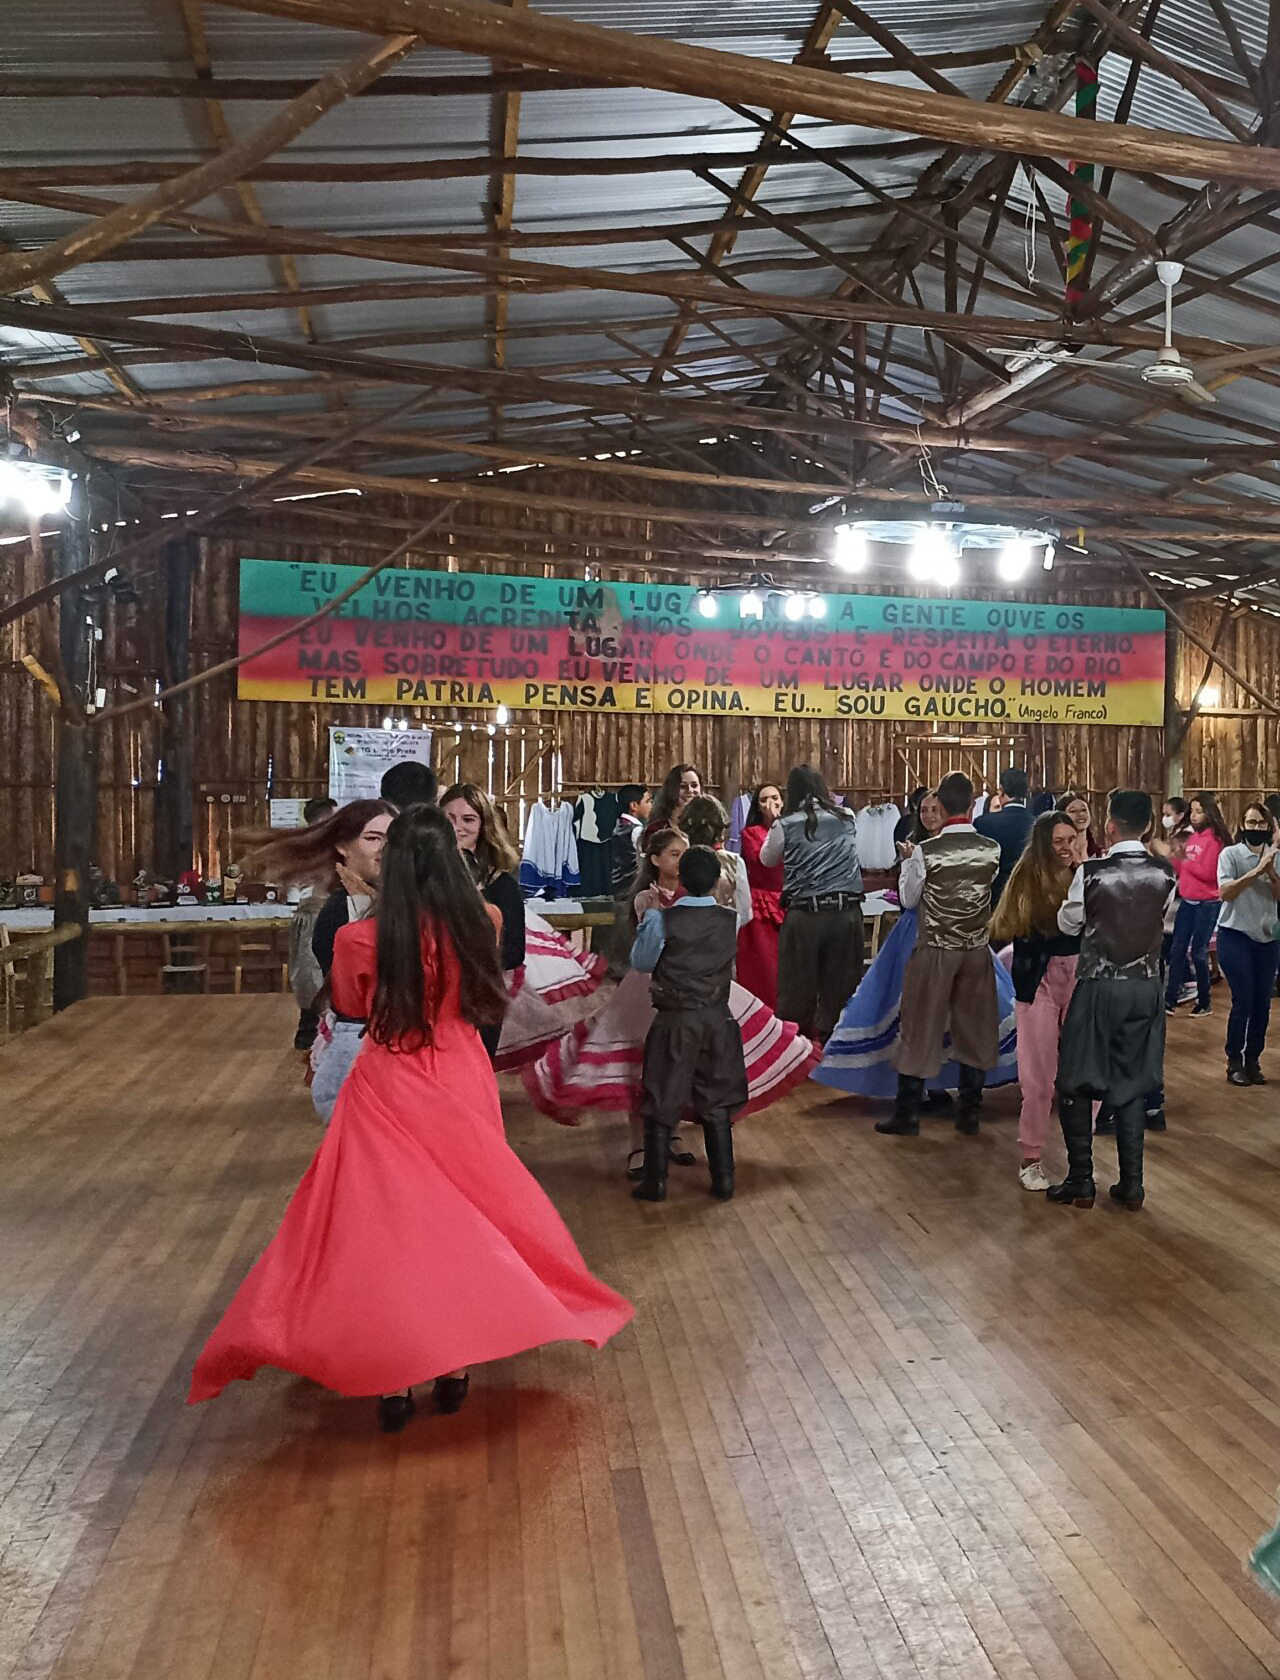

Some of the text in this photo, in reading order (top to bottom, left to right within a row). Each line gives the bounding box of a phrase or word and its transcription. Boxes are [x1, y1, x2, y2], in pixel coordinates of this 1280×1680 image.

[375, 576, 476, 601] VENHO
[501, 583, 537, 606] DE
[559, 586, 604, 609] UM
[629, 590, 705, 611] LUGA
[631, 615, 693, 637] NOS
[731, 619, 828, 643] JOVENS
[855, 625, 869, 645] E
[1023, 633, 1038, 651] O
[840, 601, 855, 621] A
[882, 603, 966, 626] GENTE
[987, 608, 1046, 630] OUVE
[1056, 612, 1085, 630] OS
[299, 622, 333, 645] EU
[354, 624, 447, 650] VENHO
[459, 630, 493, 654] DE
[510, 633, 548, 655] UM
[567, 636, 654, 660] LUGAR
[675, 641, 736, 664] ONDE
[754, 646, 770, 664] O
[785, 648, 865, 668] CANTO
[880, 651, 892, 669] E
[904, 652, 932, 670] DO
[940, 652, 1016, 673] CAMPO
[1024, 655, 1035, 673] E
[1046, 656, 1074, 675] DO
[383, 652, 540, 680] SOBRETUDO
[558, 660, 591, 681] EU
[602, 662, 686, 685] VENHO
[704, 667, 734, 687] DE
[761, 670, 799, 690] UM
[824, 673, 904, 693] LUGAR
[919, 675, 978, 695] ONDE
[989, 676, 1006, 695] O
[1020, 680, 1106, 698] HOMEM
[307, 676, 367, 699] TEM
[525, 683, 617, 707] PENSA
[635, 687, 651, 709] E
[667, 689, 750, 711] OPINA.
[774, 692, 822, 714] EU...
[837, 694, 886, 715] SOU
[1018, 704, 1108, 721] (Angelo Franco)
